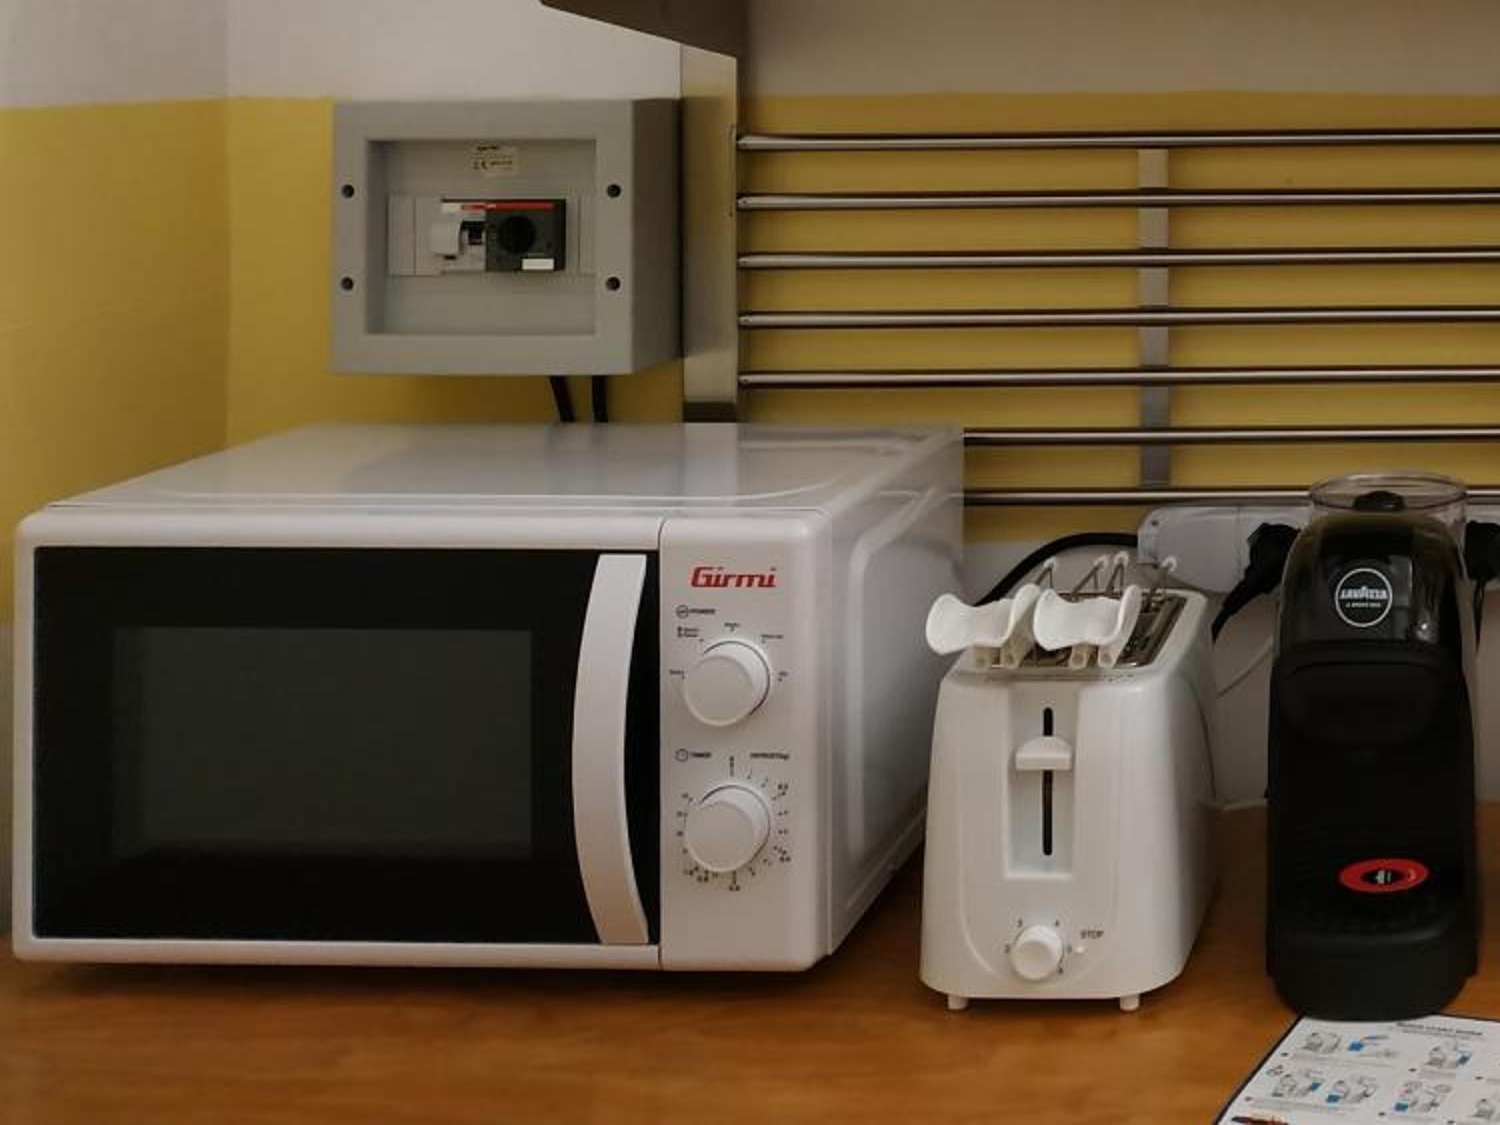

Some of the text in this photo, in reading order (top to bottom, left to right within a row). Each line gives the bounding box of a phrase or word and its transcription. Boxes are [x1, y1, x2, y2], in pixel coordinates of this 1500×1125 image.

[691, 567, 777, 588] Girmi
[1340, 586, 1388, 600] LAVAZZA
[1080, 930, 1104, 939] STOP
